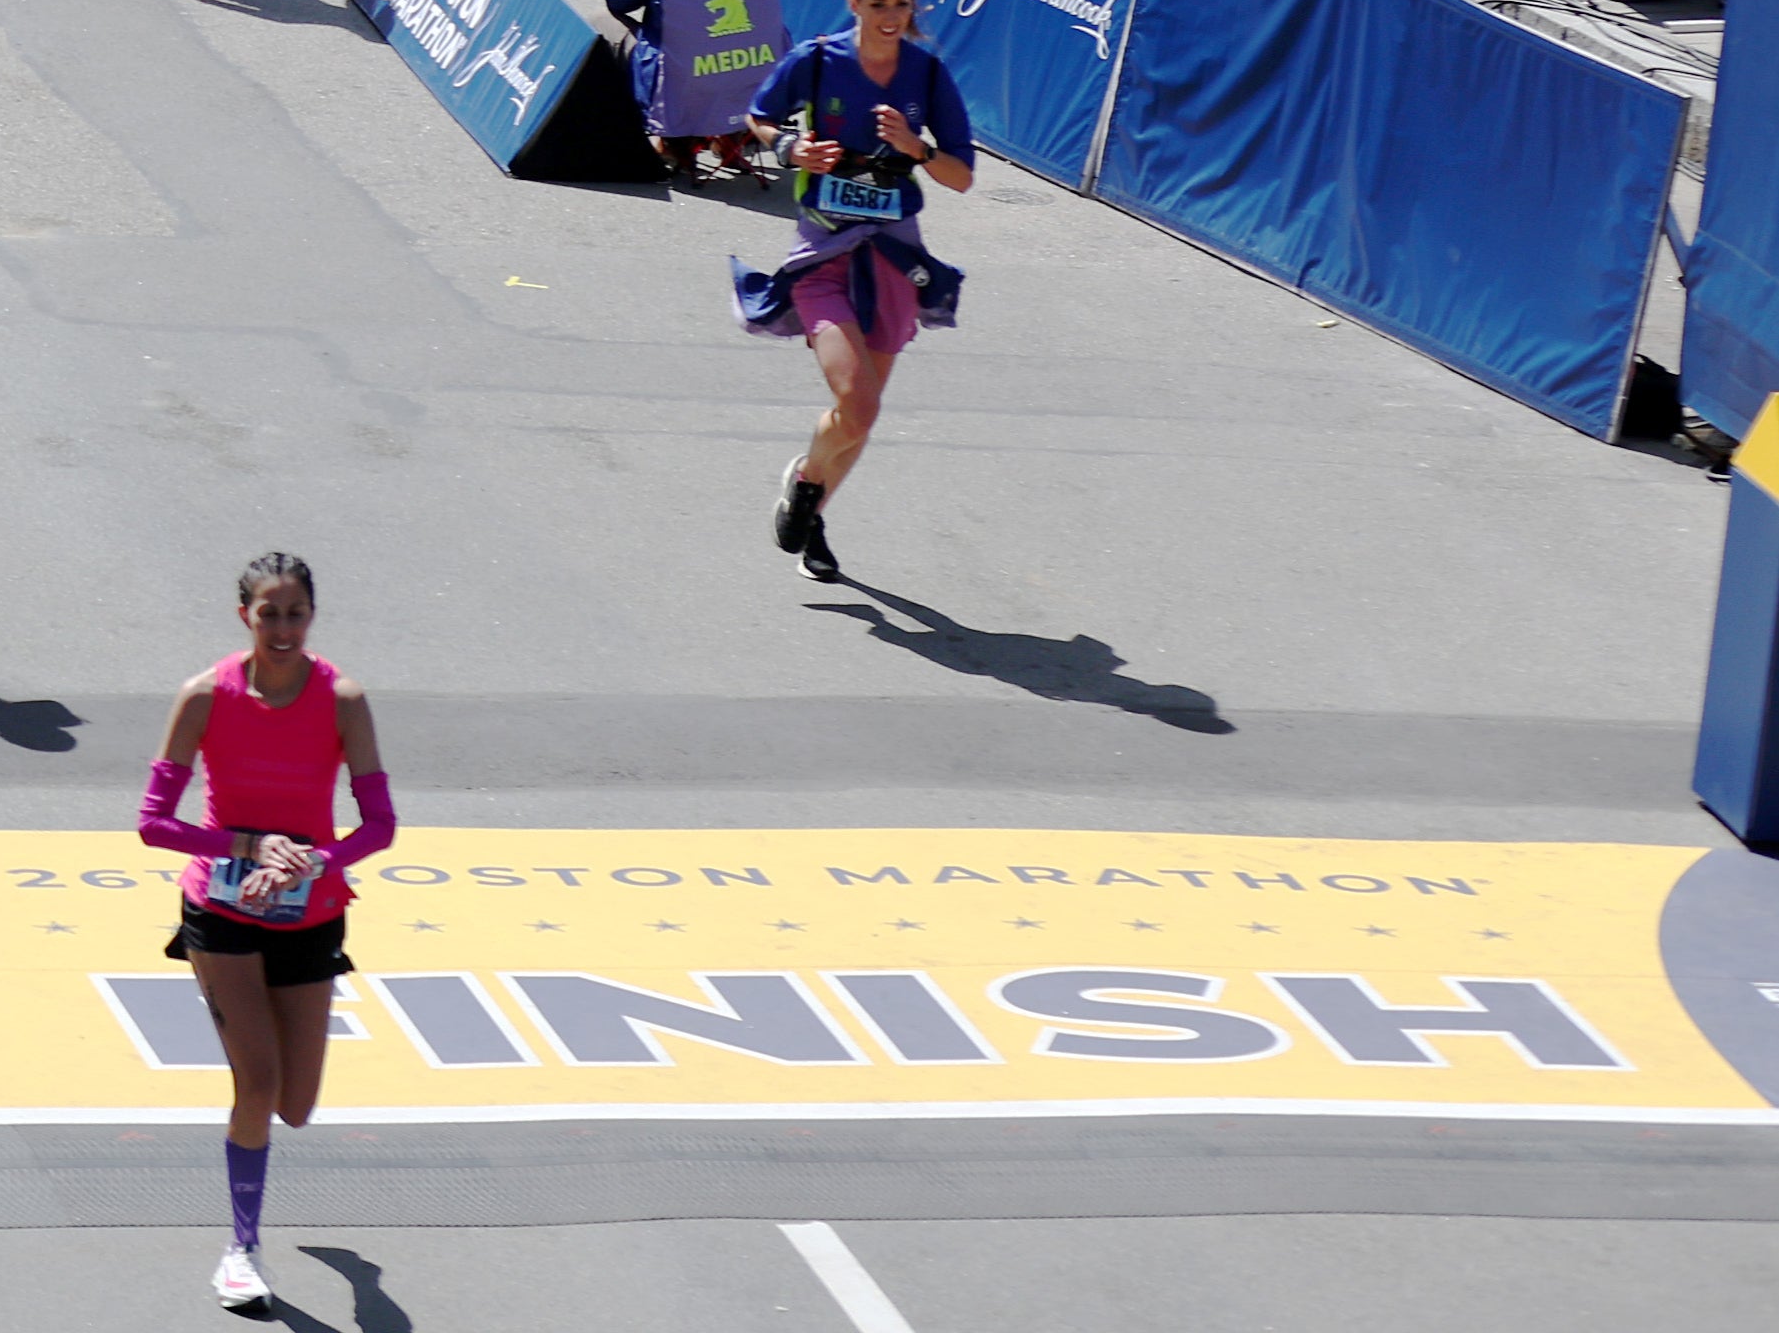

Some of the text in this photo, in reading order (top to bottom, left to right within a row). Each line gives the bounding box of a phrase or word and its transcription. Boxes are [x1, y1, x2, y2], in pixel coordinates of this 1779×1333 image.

[692, 43, 775, 77] MEDIA
[829, 174, 893, 211] 16587
[343, 864, 775, 890] OSTON
[823, 865, 1483, 899] MARATHON
